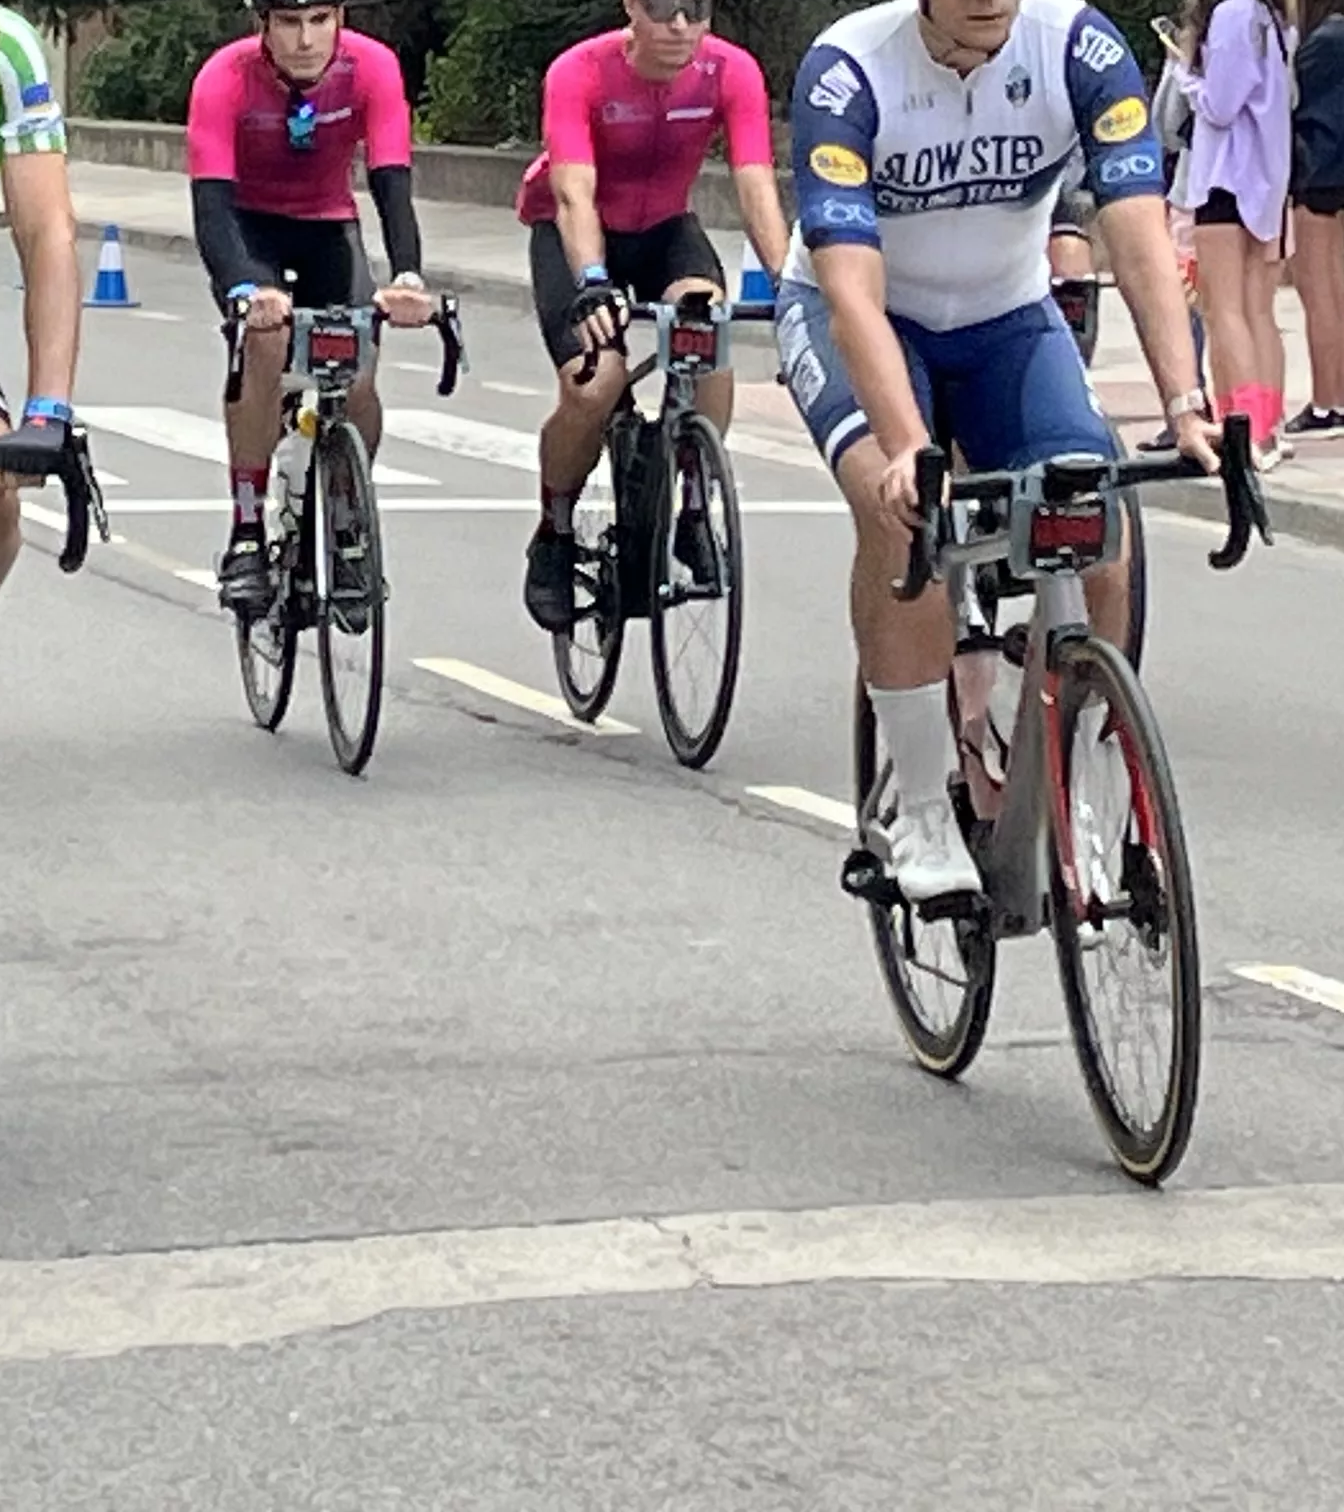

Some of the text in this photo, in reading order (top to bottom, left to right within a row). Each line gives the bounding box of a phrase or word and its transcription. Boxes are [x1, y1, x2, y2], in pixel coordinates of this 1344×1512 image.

[1072, 24, 1125, 73] STEP
[875, 140, 965, 188] SLOW
[968, 135, 1045, 175] STEP
